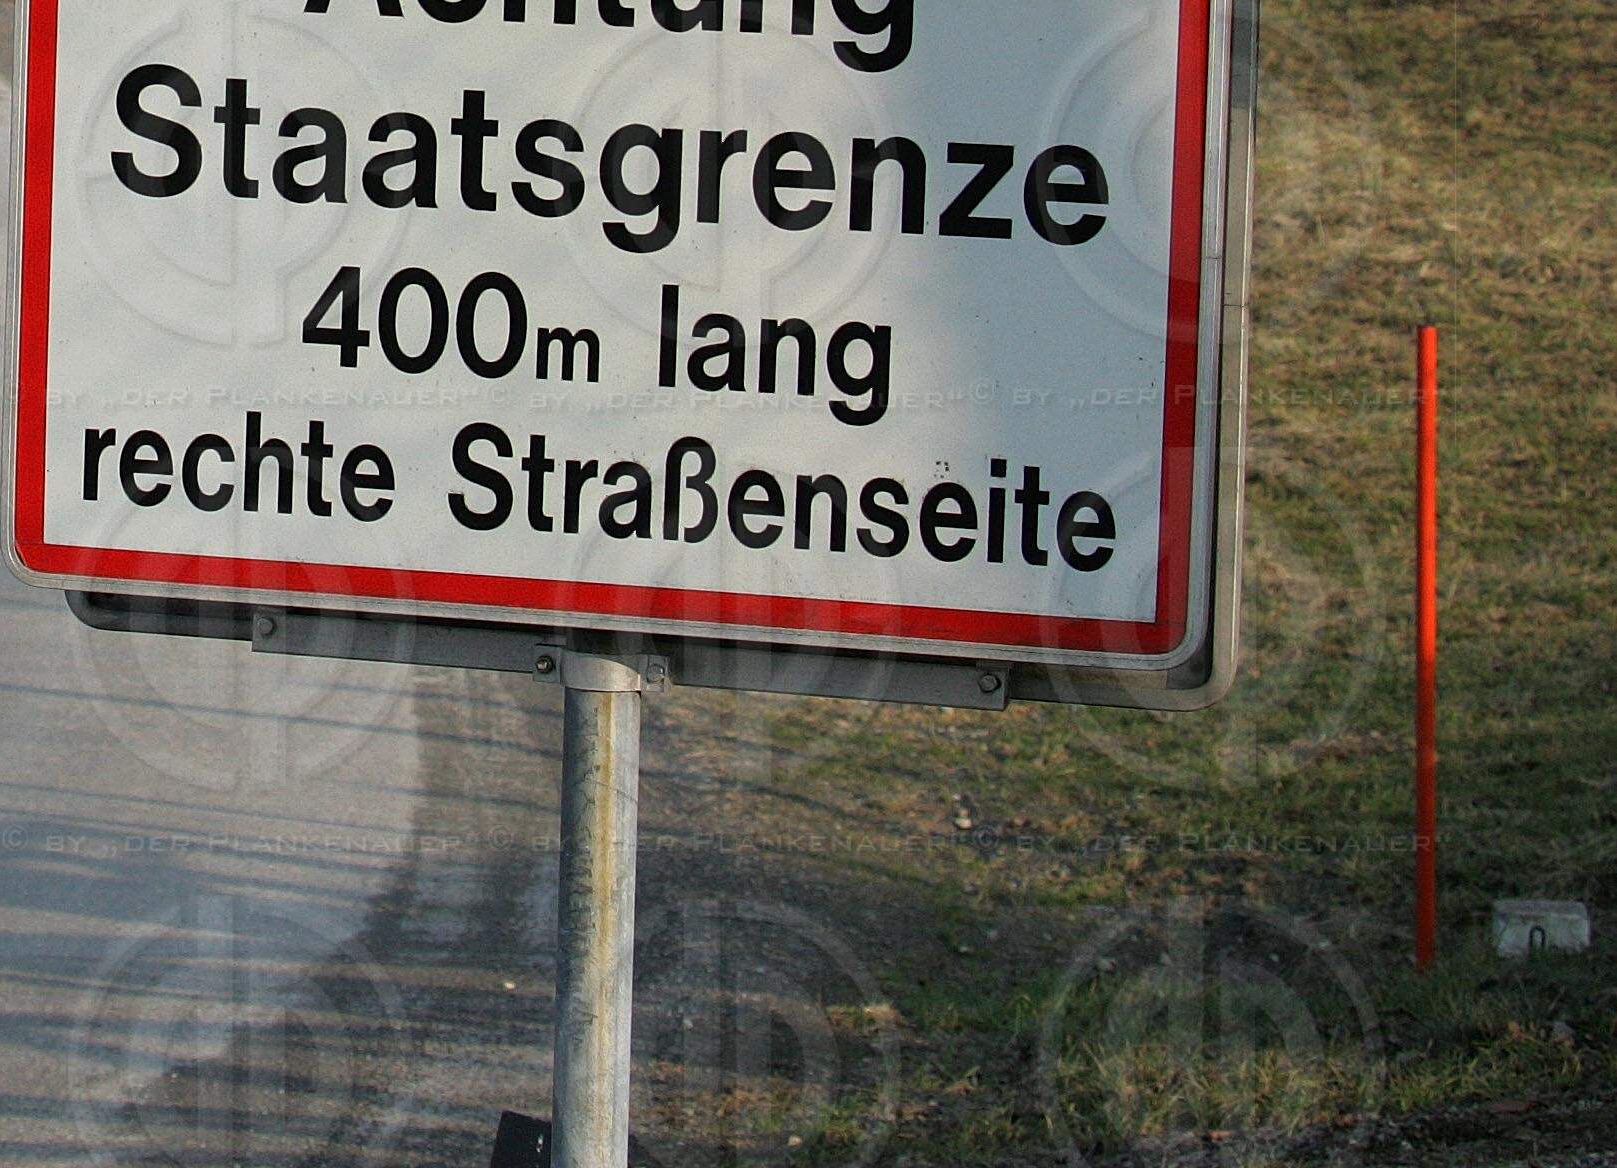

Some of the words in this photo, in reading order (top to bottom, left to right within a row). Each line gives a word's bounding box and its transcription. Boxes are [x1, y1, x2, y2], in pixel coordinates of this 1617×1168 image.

[109, 62, 1111, 255] Staatsgrenze
[301, 264, 601, 384] 400m
[657, 282, 893, 428] lang
[81, 409, 397, 524] rechte
[446, 421, 1118, 574] Straßenseite
